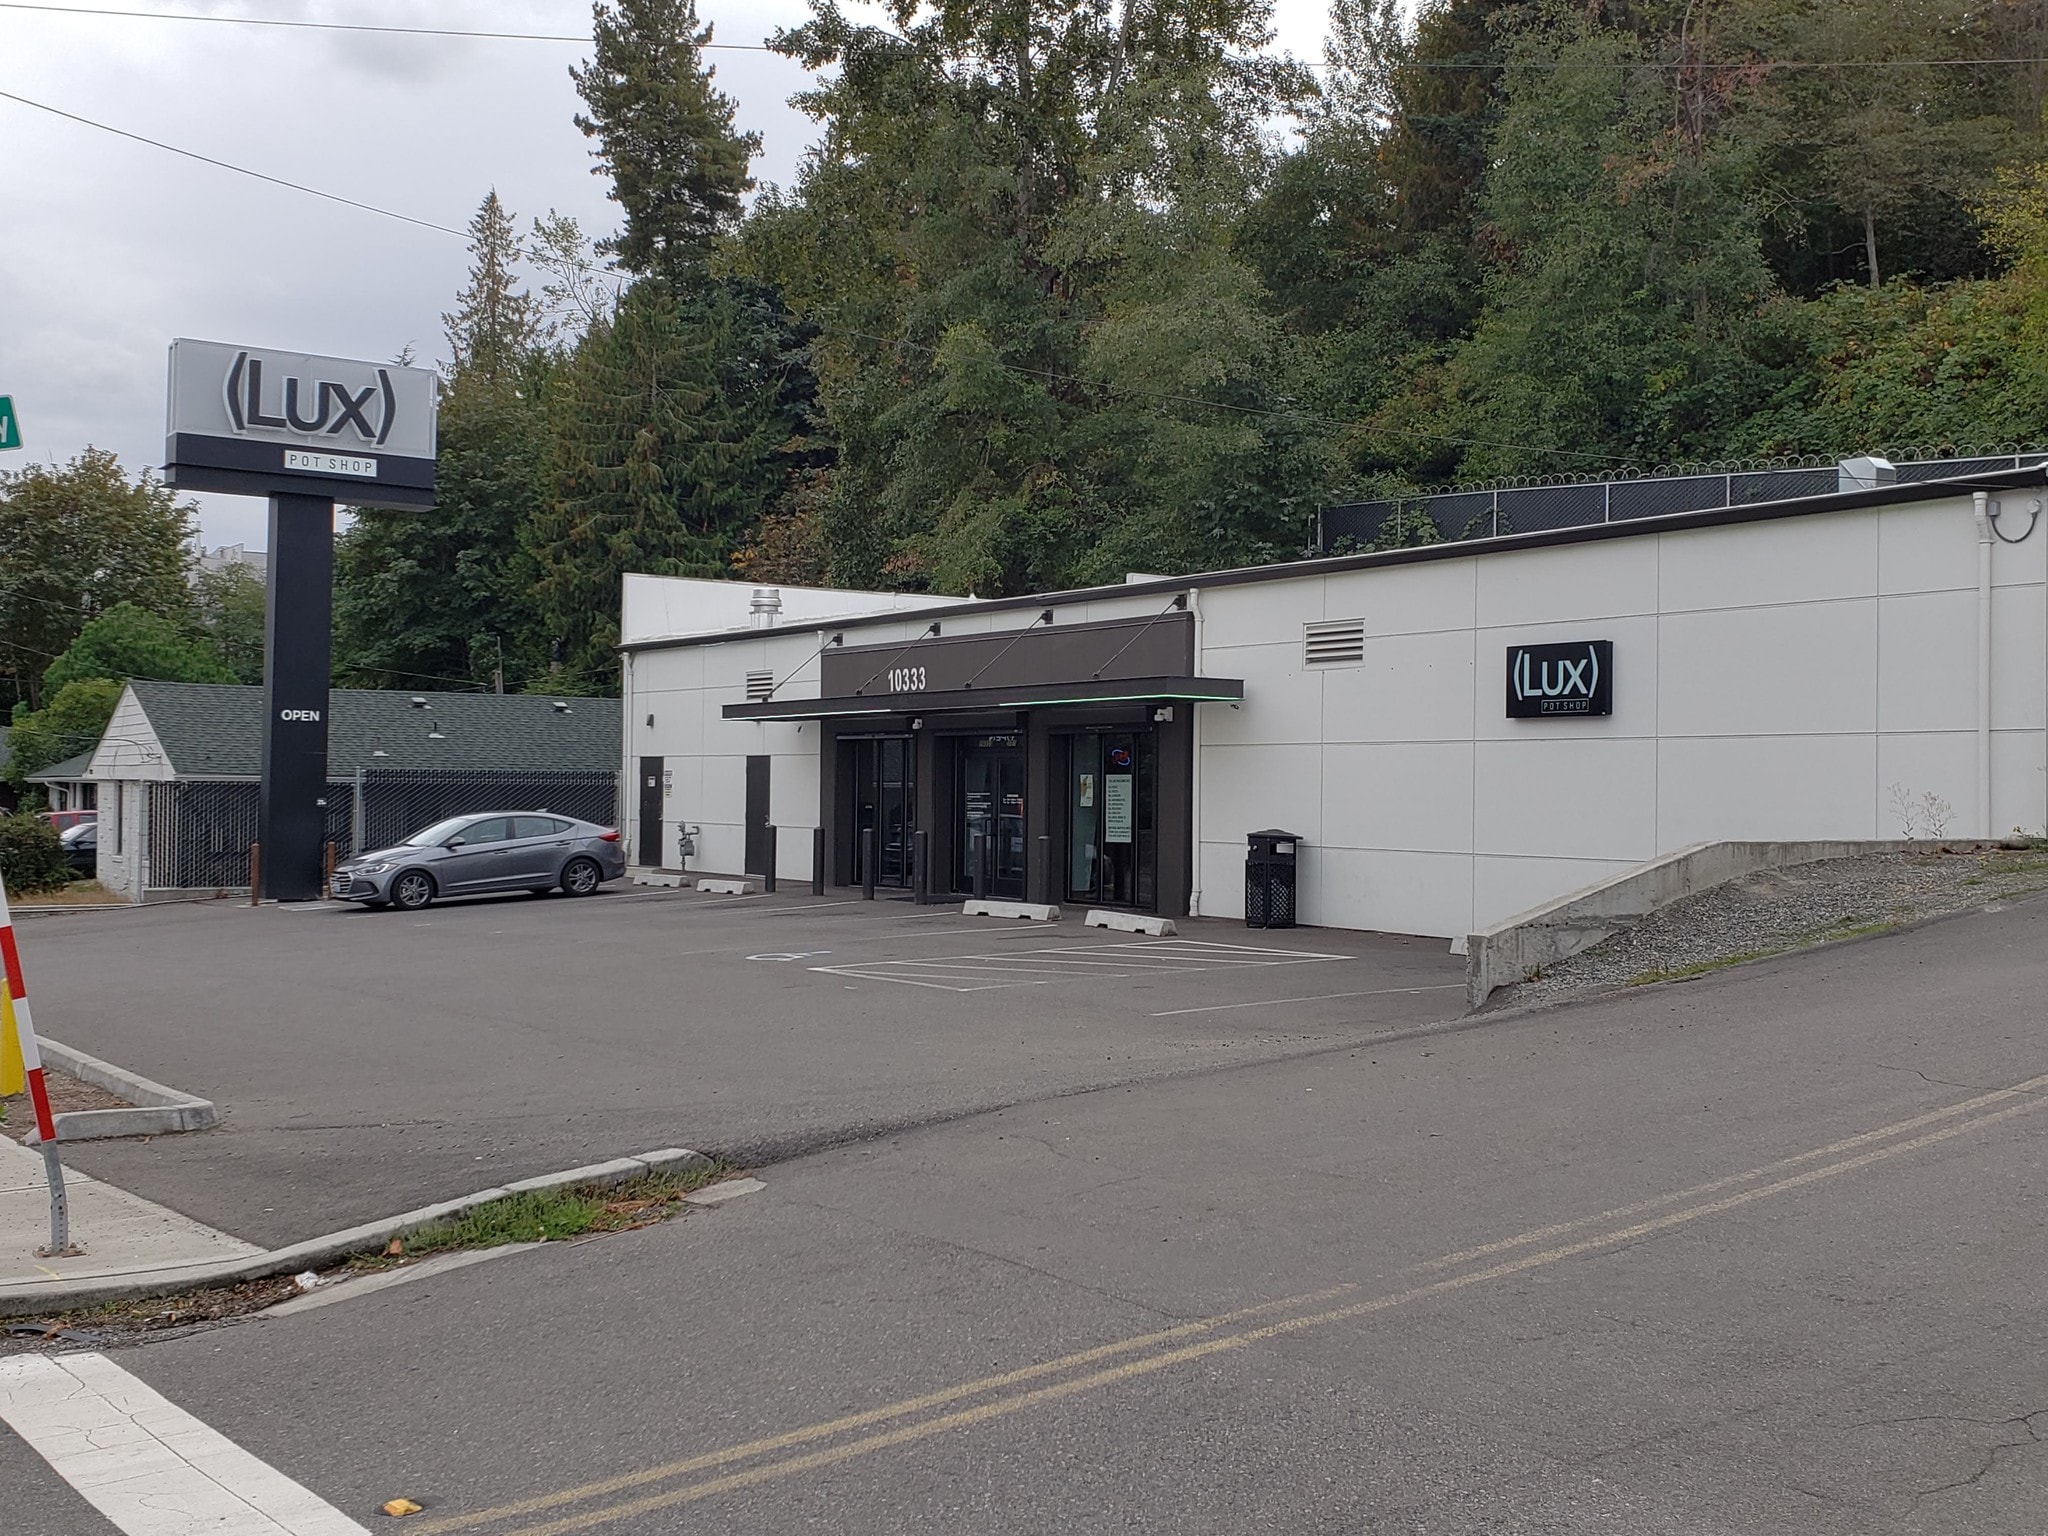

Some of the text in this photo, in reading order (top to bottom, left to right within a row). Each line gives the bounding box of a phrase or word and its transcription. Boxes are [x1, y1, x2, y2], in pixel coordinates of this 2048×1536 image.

[289, 454, 374, 473] POT SHOP
[888, 666, 926, 692] 10333
[1543, 701, 1587, 711] POT SHOP
[280, 709, 320, 722] OPEN
